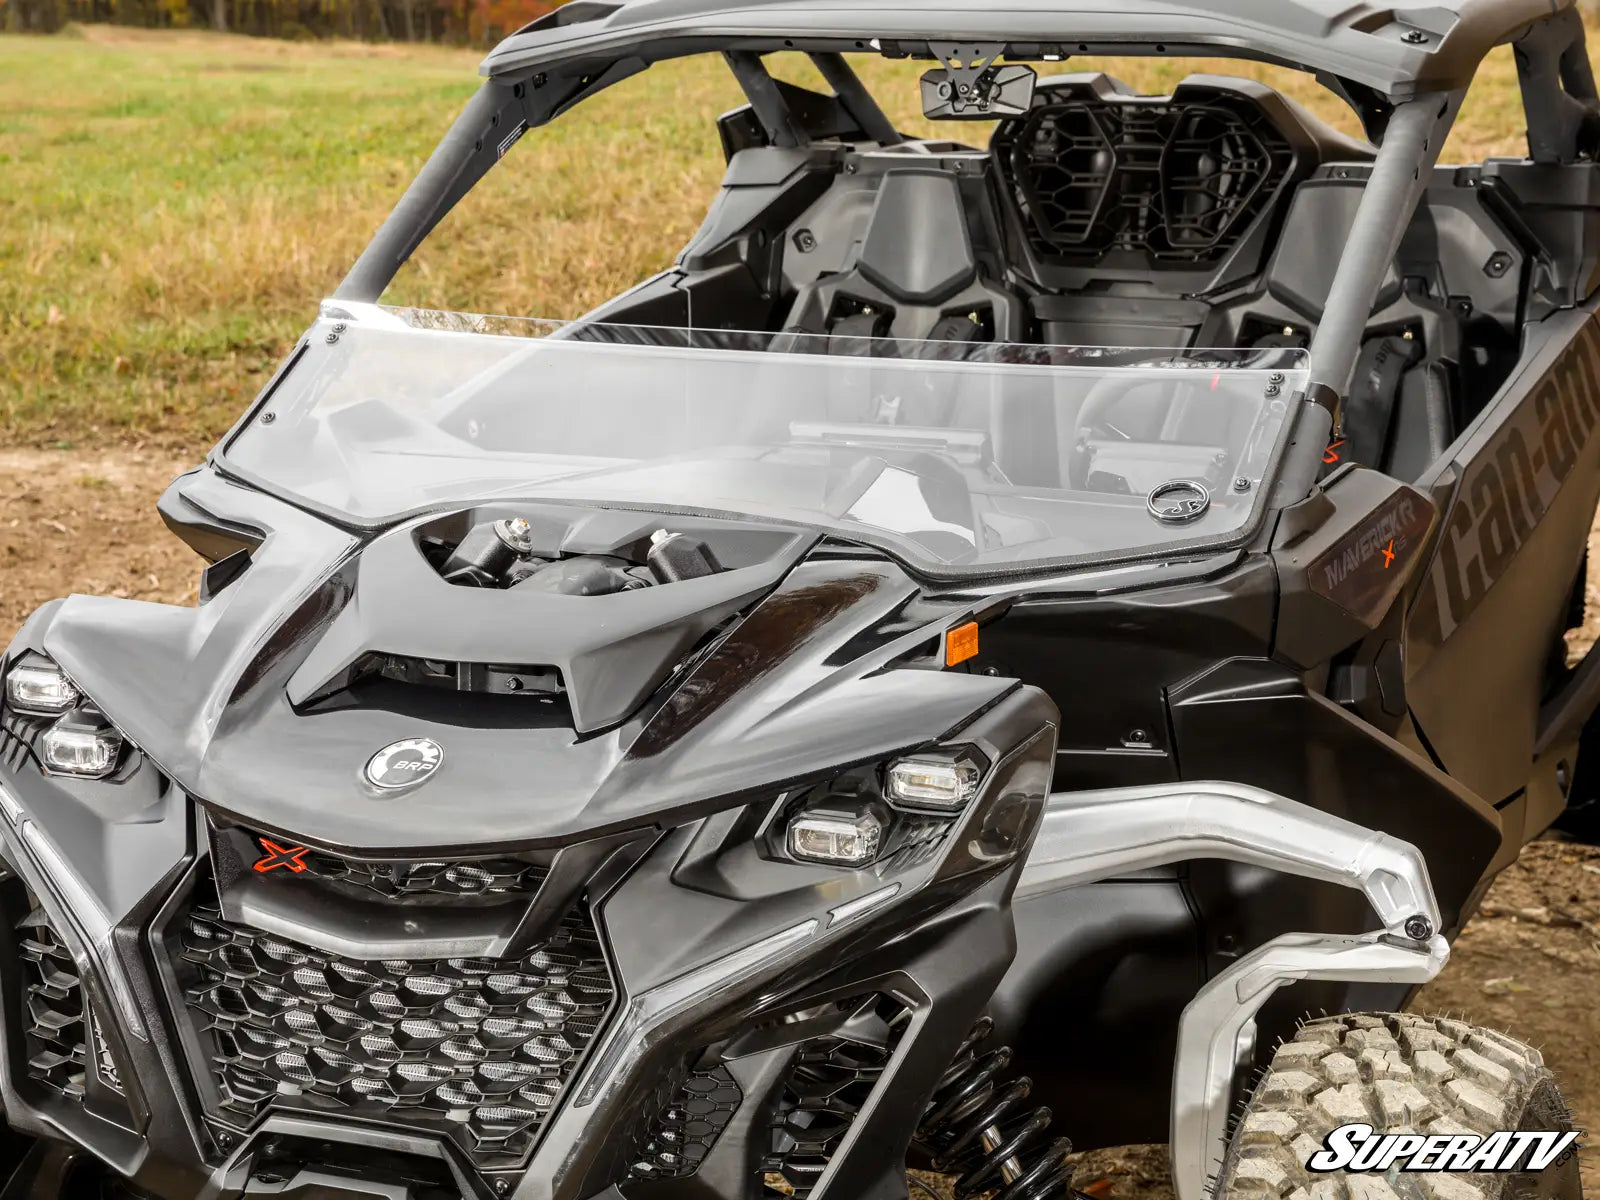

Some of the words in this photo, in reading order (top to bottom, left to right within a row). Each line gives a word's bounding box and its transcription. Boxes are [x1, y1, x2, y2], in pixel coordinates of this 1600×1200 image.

[1324, 506, 1402, 590] MAVERICK
[1398, 497, 1417, 527] R
[392, 760, 434, 771] BRP
